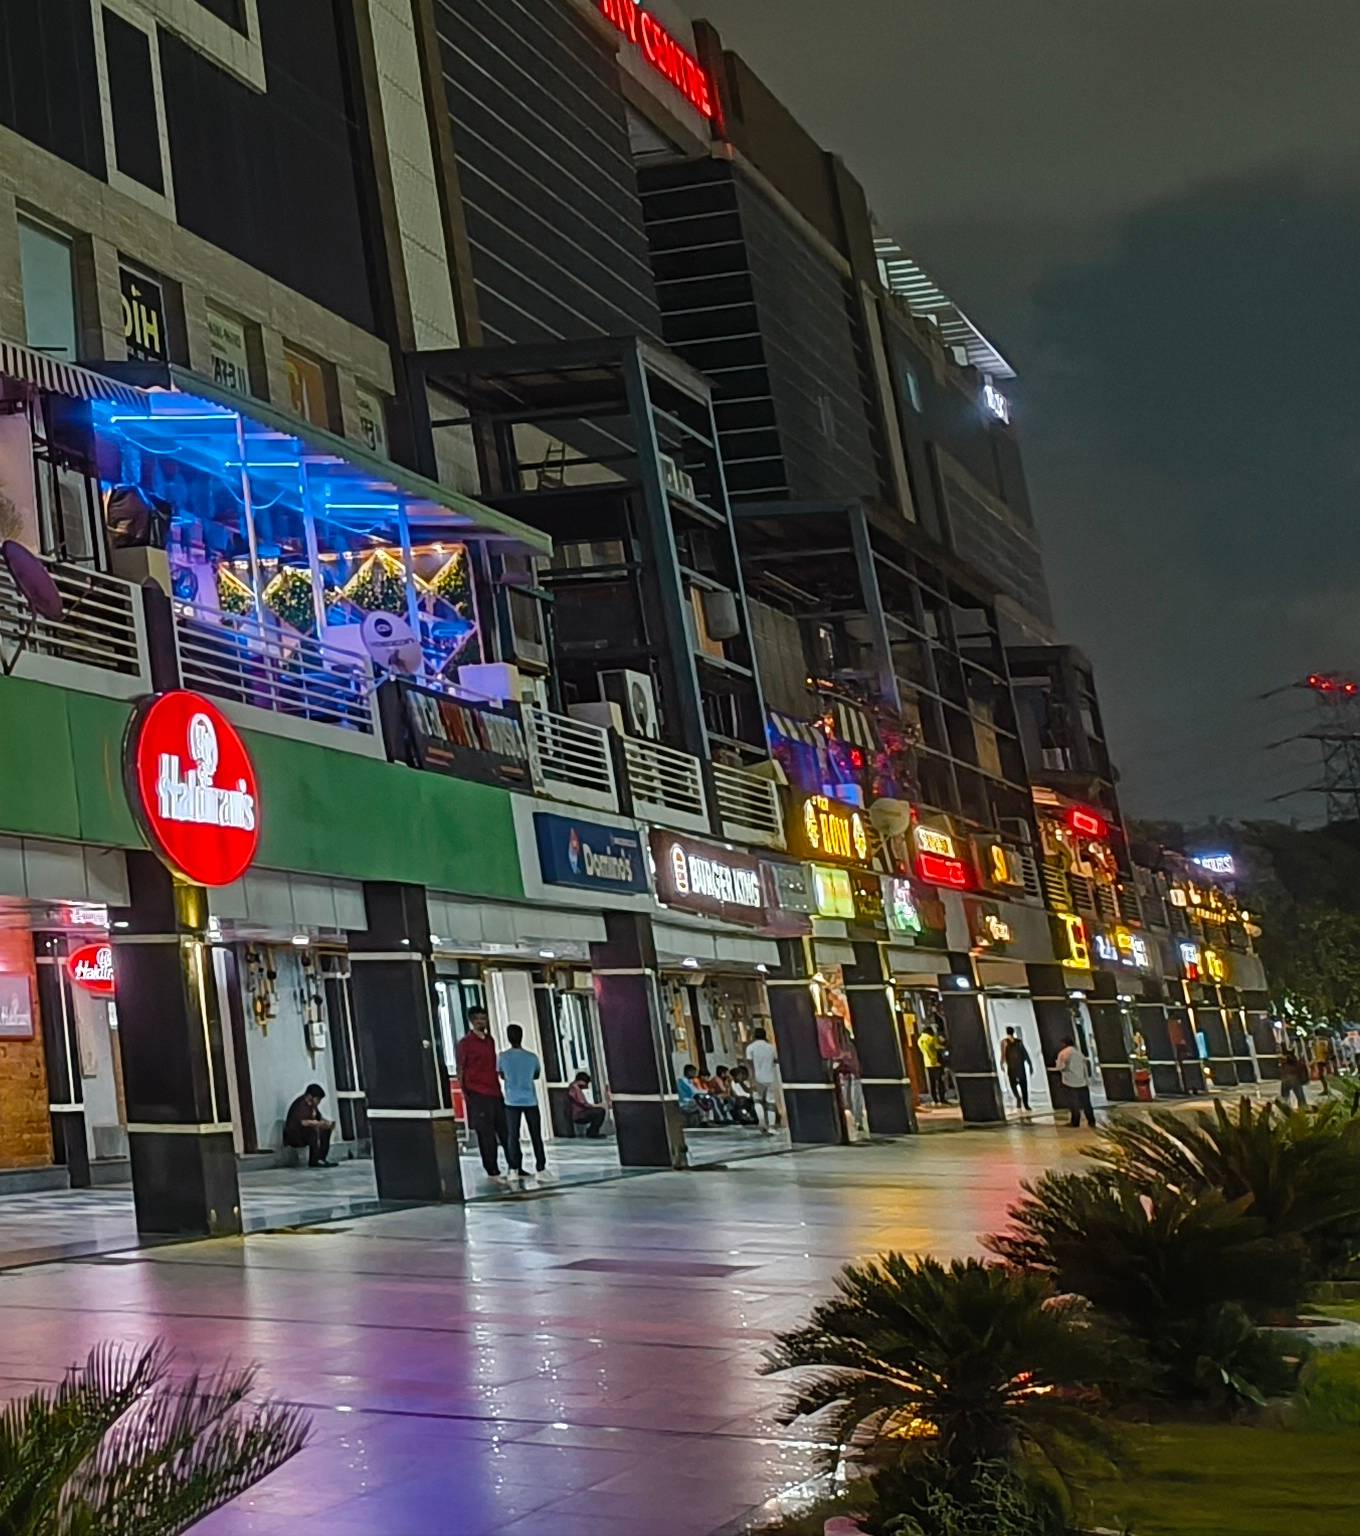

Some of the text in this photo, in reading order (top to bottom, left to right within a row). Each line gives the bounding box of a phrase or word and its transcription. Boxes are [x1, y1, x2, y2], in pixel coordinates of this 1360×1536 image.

[156, 753, 255, 831] Haldiram's
[583, 843, 633, 882] Domino's
[688, 854, 761, 908] BURGER KING
[74, 959, 113, 980] Haldir
